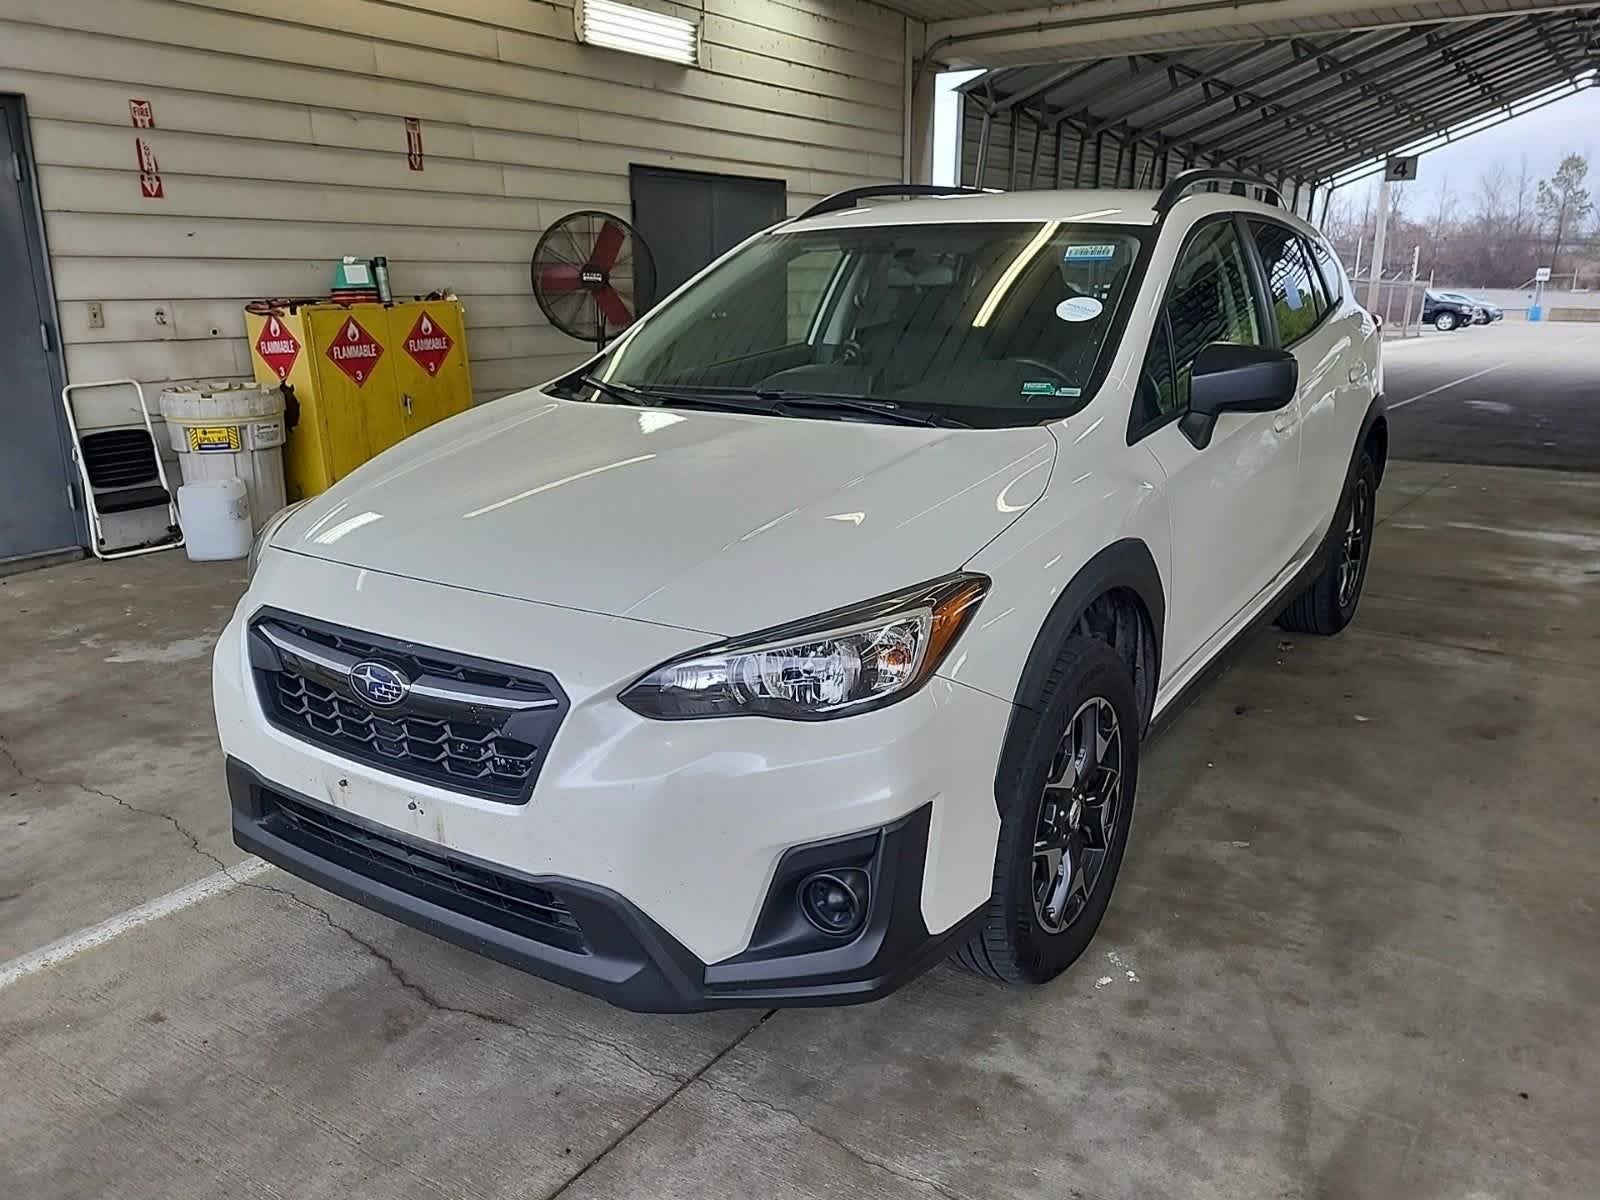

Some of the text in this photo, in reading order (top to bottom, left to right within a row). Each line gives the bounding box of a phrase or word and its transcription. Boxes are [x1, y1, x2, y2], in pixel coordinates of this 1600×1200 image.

[133, 106, 150, 117] FIRE
[1393, 161, 1408, 178] 4
[260, 340, 295, 355] FLAMMABLE
[408, 337, 448, 352] FLAMMABLE
[333, 343, 377, 360] FLAMMABLE
[279, 366, 286, 377] 3
[428, 362, 435, 372] 3
[355, 370, 363, 381] 3
